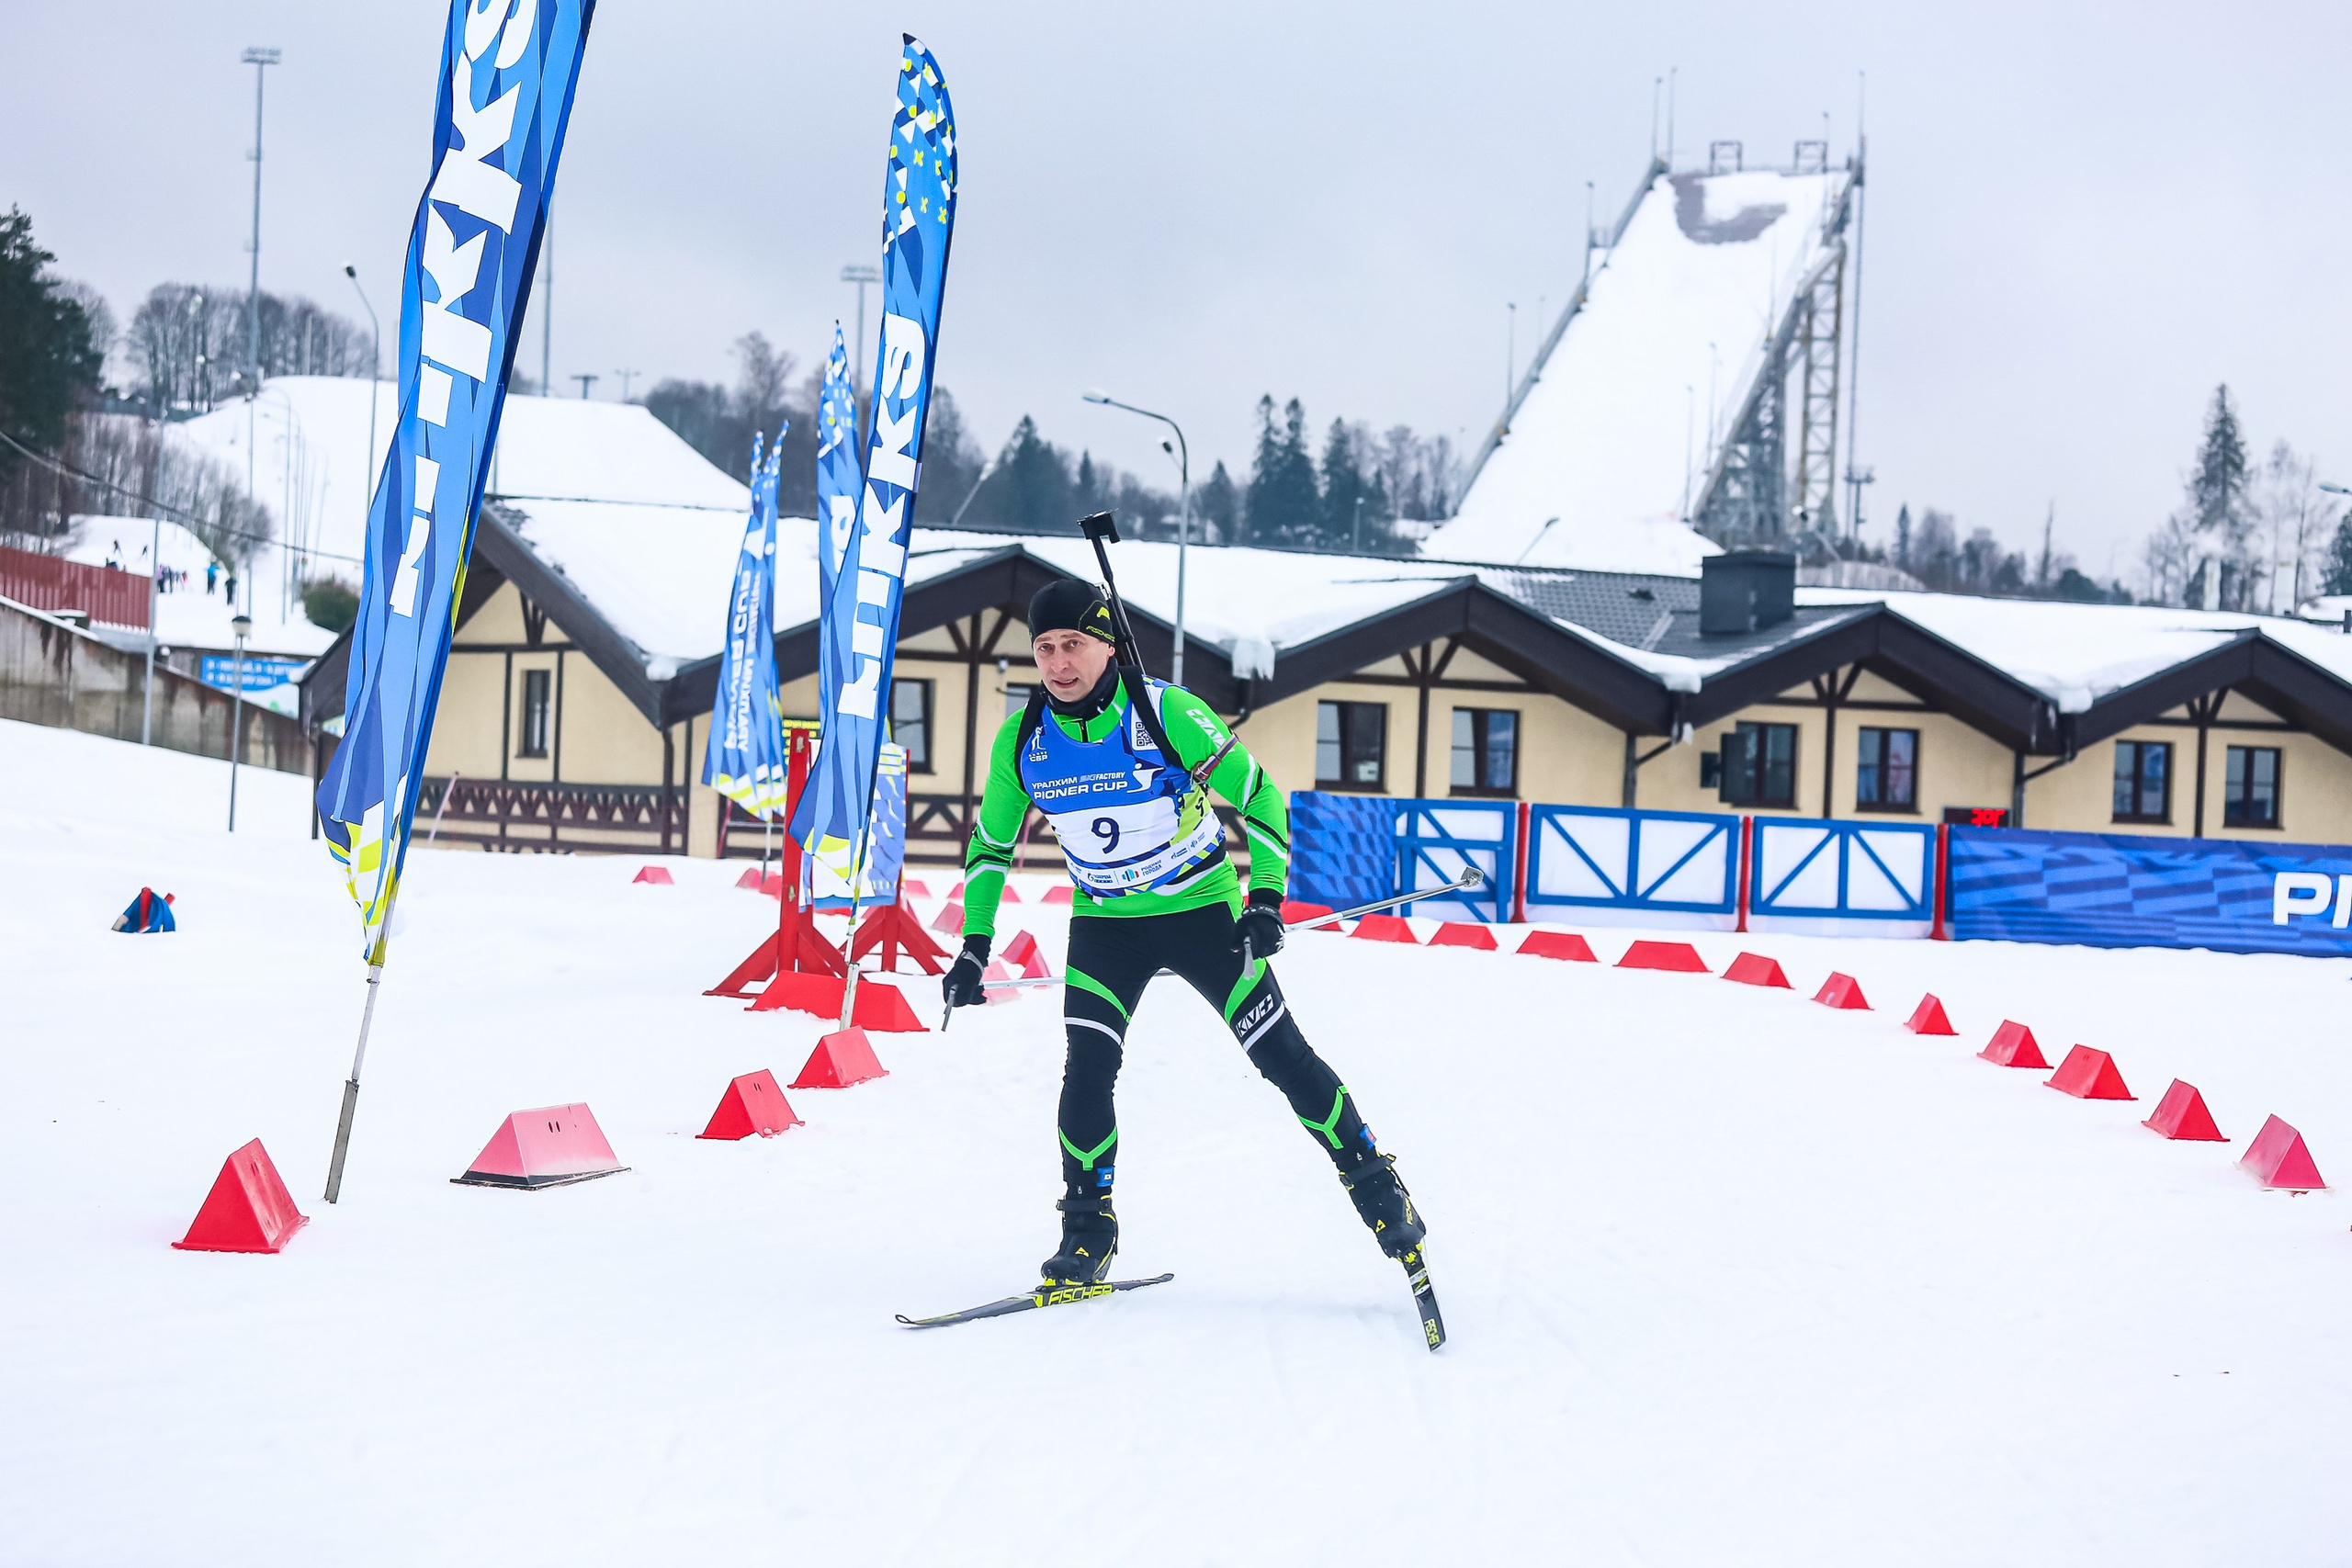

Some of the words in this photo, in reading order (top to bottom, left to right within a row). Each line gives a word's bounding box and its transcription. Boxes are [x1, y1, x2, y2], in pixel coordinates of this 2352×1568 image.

[1029, 754, 1048, 762] СБР
[1032, 776, 1078, 790] УРАЛХИМ
[1034, 784, 1090, 800] PIONER
[1091, 781, 1128, 793] CUP
[1091, 817, 1120, 854] 9
[1048, 1284, 1114, 1306] FISCHER
